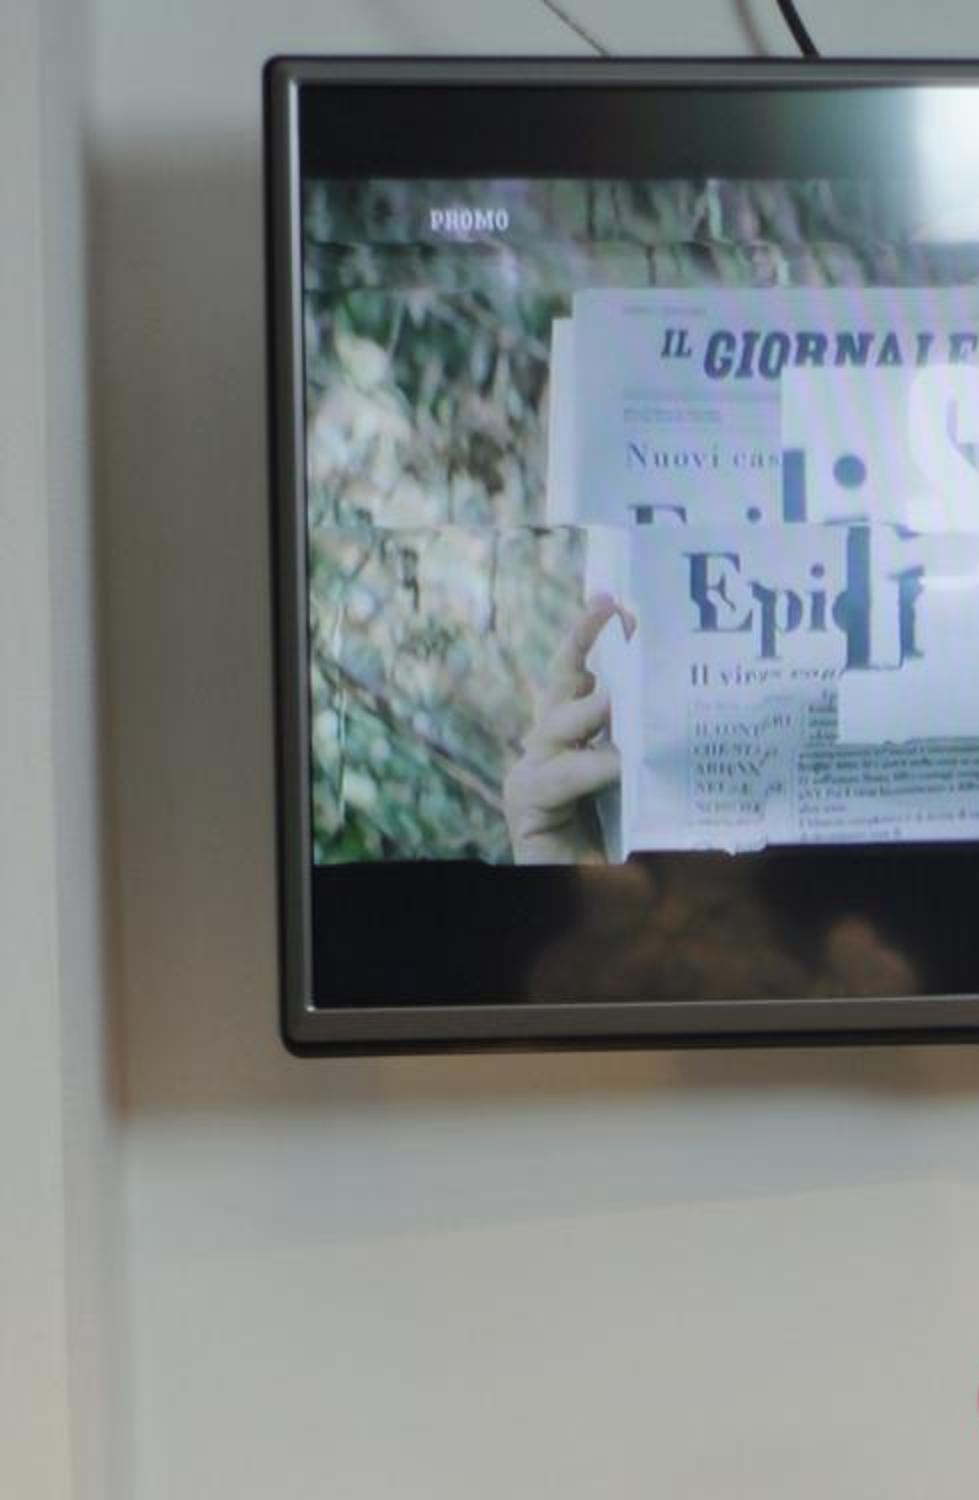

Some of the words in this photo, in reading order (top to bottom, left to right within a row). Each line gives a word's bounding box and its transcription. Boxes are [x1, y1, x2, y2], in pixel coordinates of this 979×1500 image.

[430, 207, 509, 230] PROMO
[661, 329, 692, 358] IL
[703, 331, 979, 379] GIORNALE
[628, 442, 718, 468] Nuovi
[733, 454, 782, 469] cas
